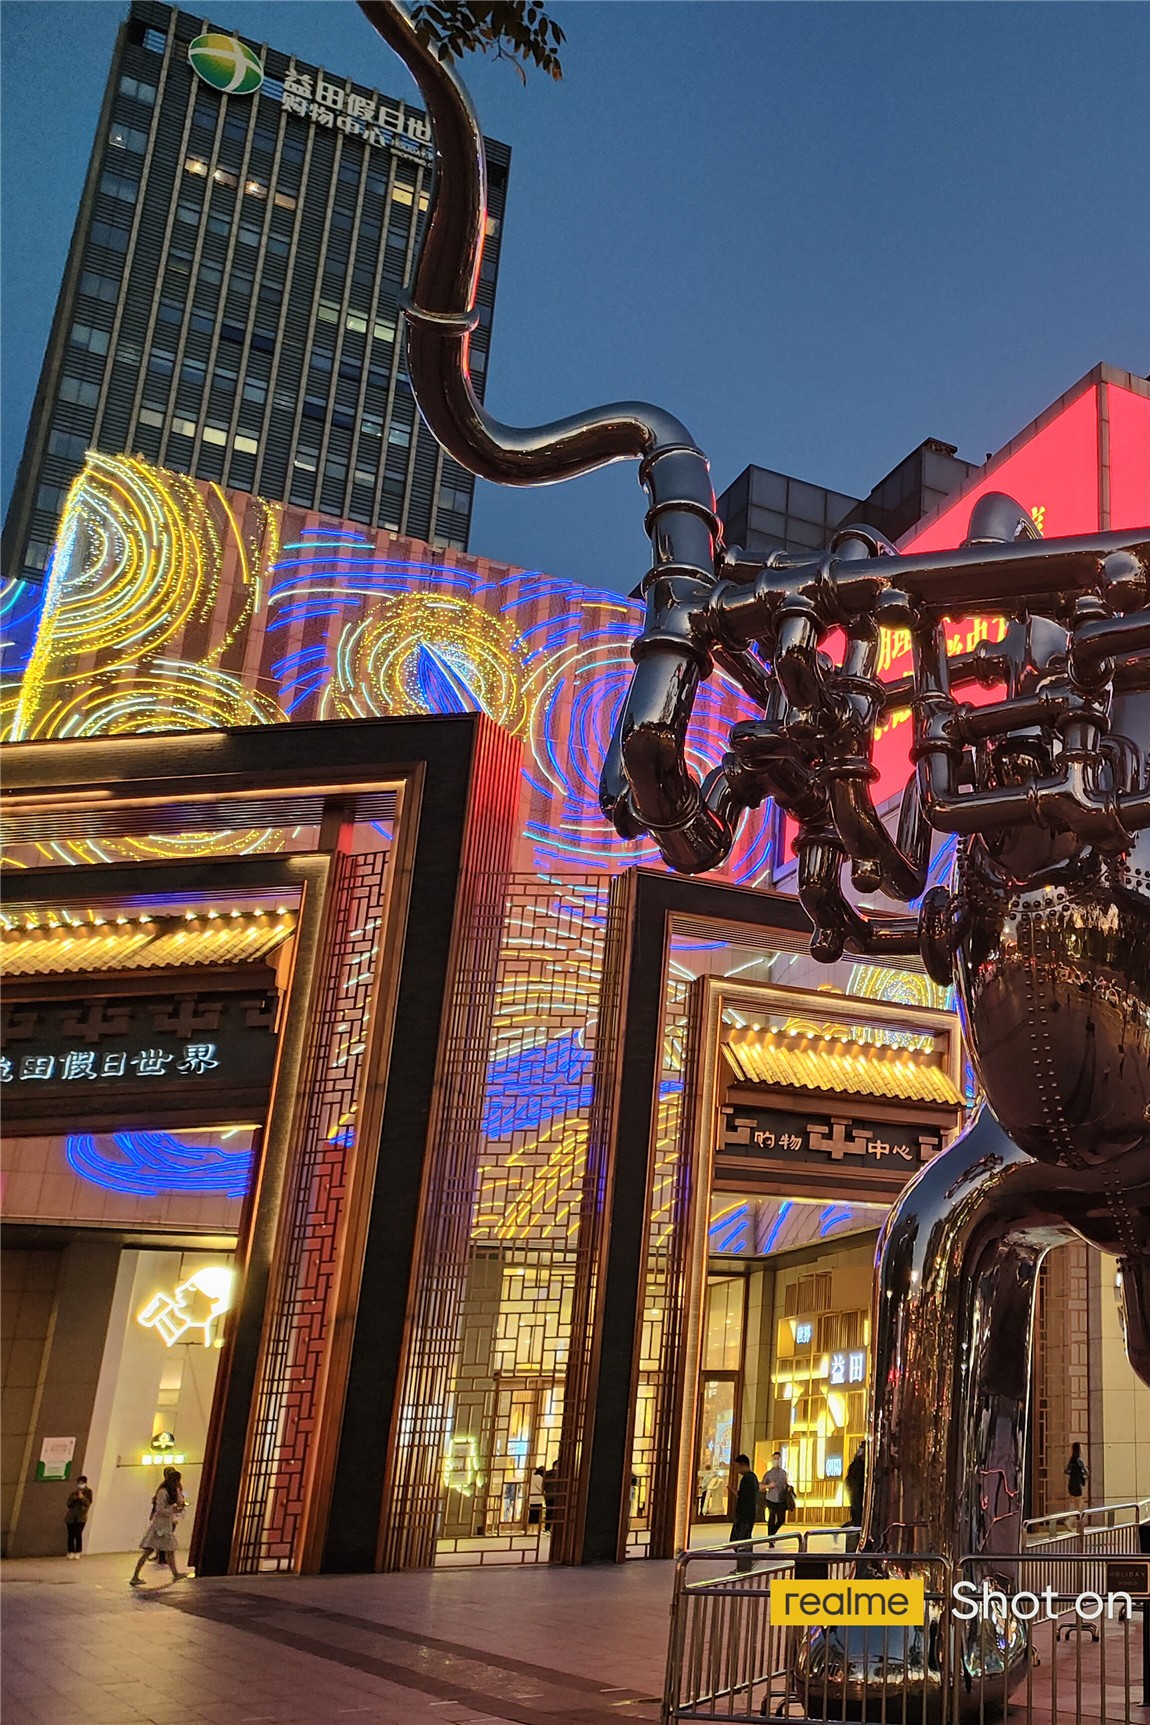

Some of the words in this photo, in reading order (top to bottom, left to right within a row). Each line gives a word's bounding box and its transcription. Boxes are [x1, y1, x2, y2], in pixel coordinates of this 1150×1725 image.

[282, 93, 386, 148] 购物中心
[283, 71, 433, 147] 益田假日世
[753, 1130, 802, 1151] 购物
[867, 1139, 913, 1161] 中心
[830, 1351, 864, 1385] 益田
